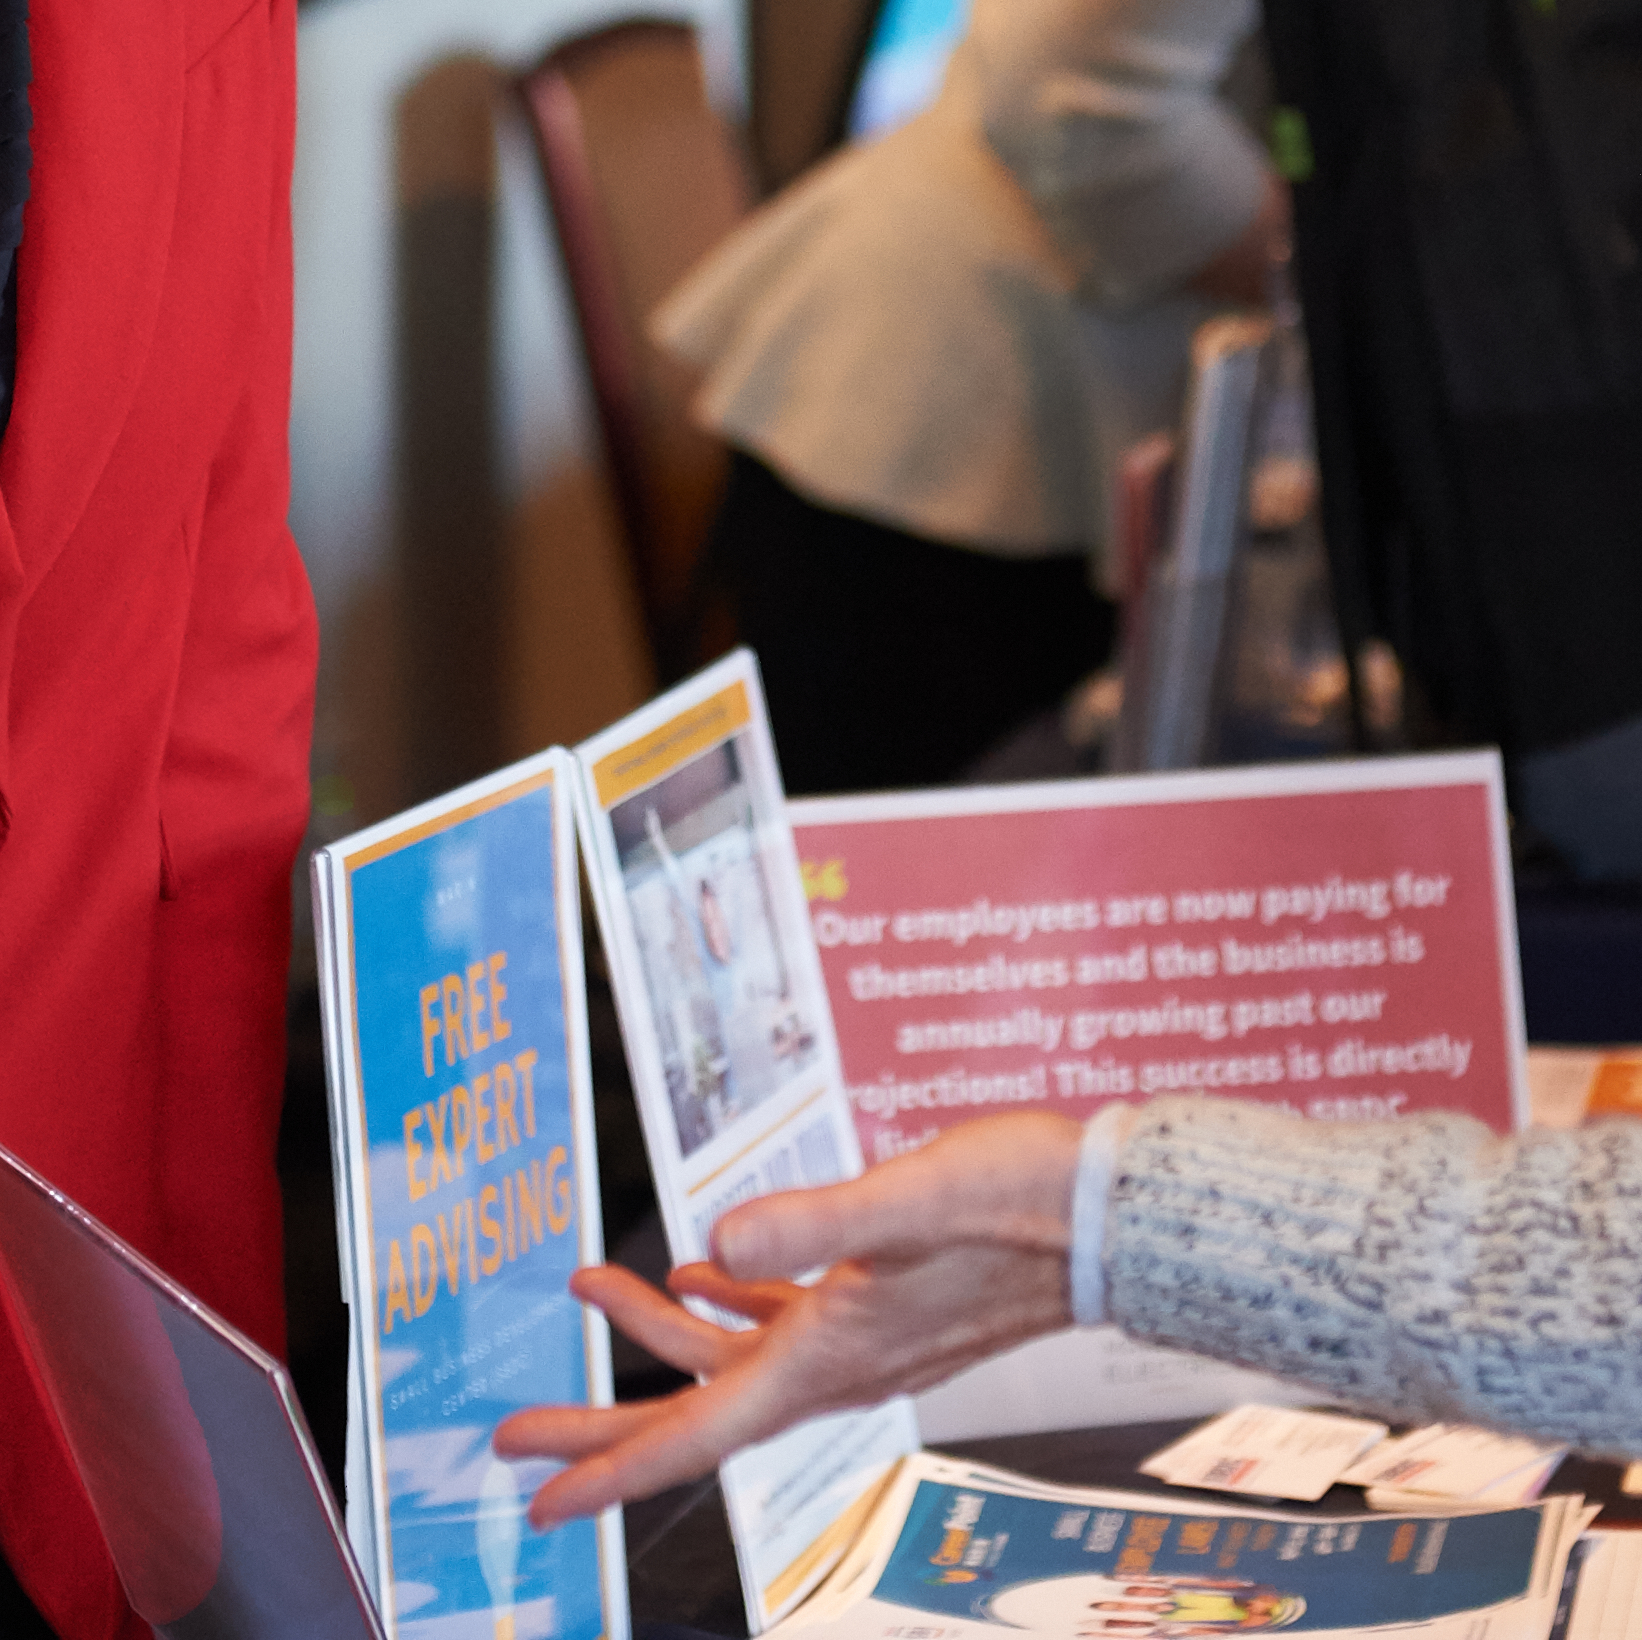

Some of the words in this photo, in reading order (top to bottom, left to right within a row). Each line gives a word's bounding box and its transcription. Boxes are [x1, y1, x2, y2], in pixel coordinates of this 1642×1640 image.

[814, 911, 887, 947] Our
[892, 896, 1101, 947] employees
[1104, 894, 1168, 927] are
[1172, 889, 1256, 922] now
[1260, 873, 1391, 926] paying
[1392, 869, 1452, 909] for
[848, 952, 1069, 1002] themselves
[1076, 944, 1147, 985] and
[1152, 940, 1218, 979] the
[1220, 931, 1386, 976] business
[1387, 923, 1425, 963] is
[419, 950, 511, 1078] FREE
[897, 1006, 1064, 1054] annually
[1069, 994, 1228, 1051] growing
[1231, 989, 1314, 1038] past
[1319, 988, 1387, 1024] our
[845, 1063, 1047, 1119] rojections!
[1054, 1054, 1135, 1098] This
[1138, 1055, 1285, 1093] success
[1286, 1041, 1322, 1081] is
[1327, 1033, 1472, 1080] directly
[403, 1046, 538, 1202] EXPERT
[383, 1145, 572, 1334] ADVISING
